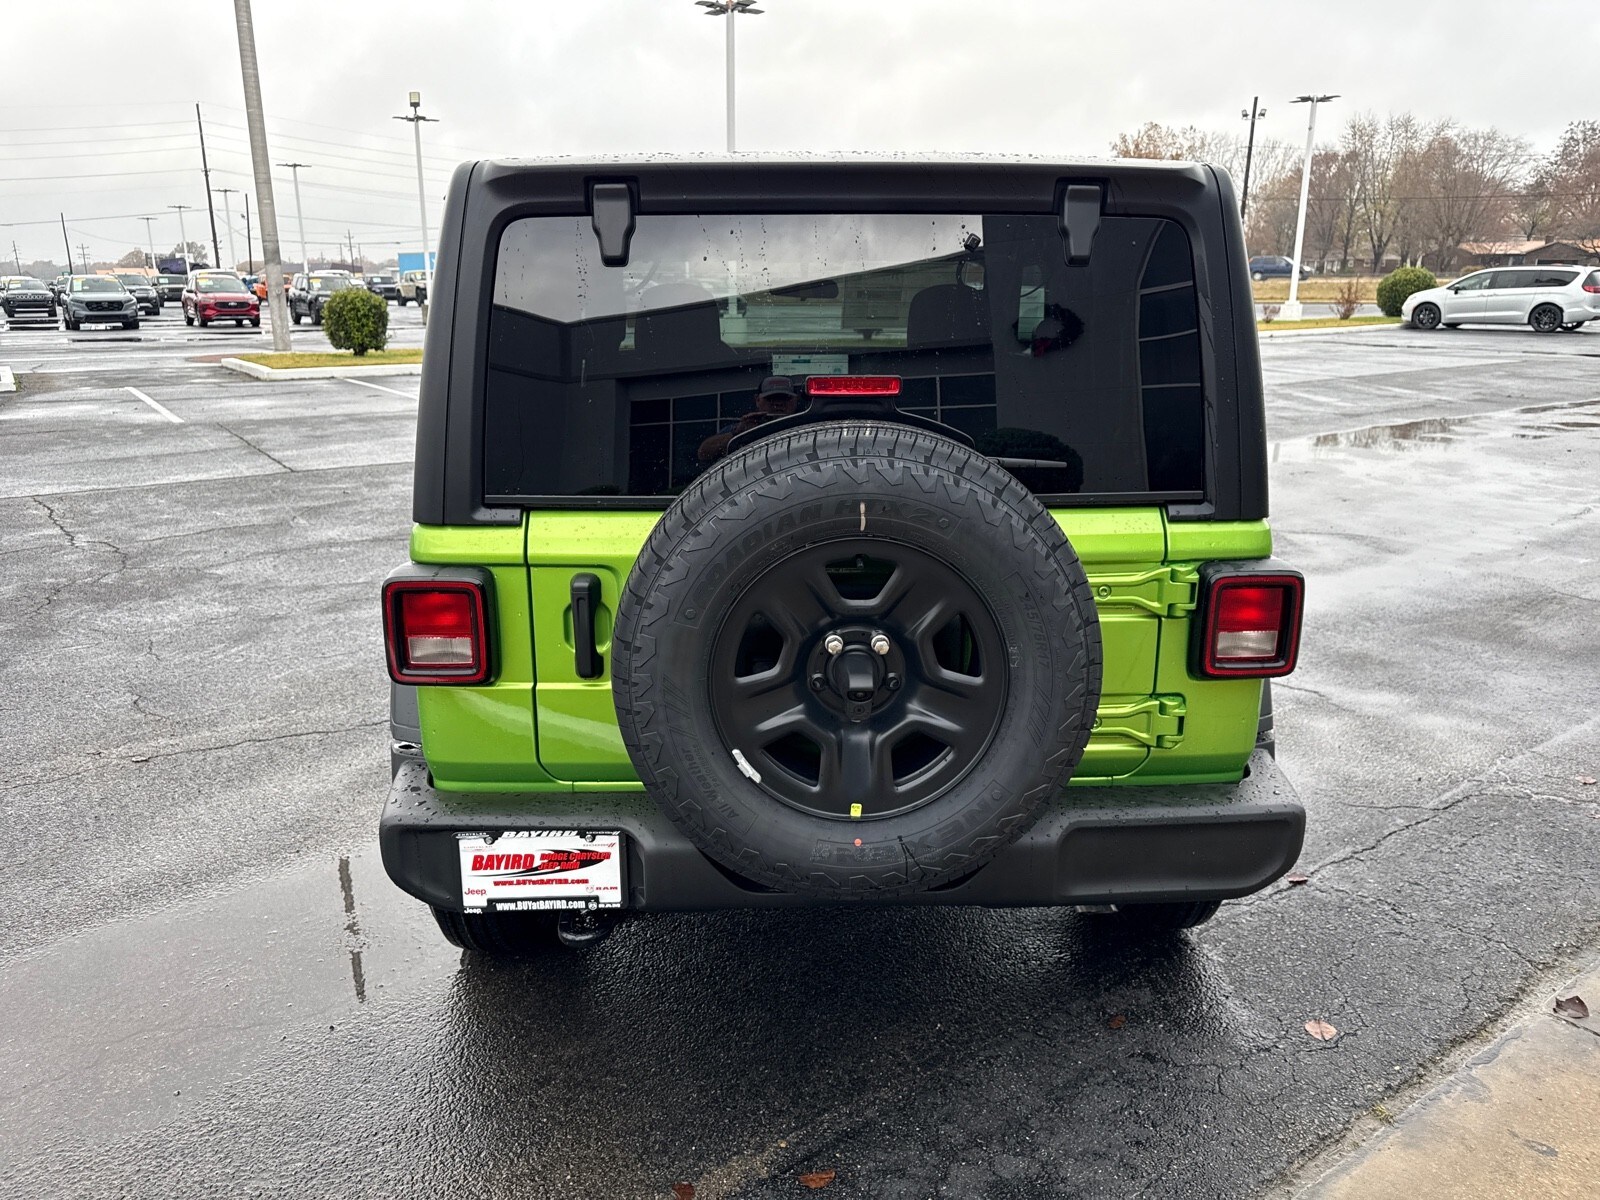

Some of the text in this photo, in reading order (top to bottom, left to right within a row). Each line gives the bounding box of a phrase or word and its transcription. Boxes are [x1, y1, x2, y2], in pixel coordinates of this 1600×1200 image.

[540, 851, 611, 861] DODGE CHRYSLER
[472, 854, 535, 871] BAYIRD
[538, 862, 559, 870] JEEP
[464, 888, 487, 896] Jeep
[496, 900, 586, 911] www.BUYatBAYIRD.com
